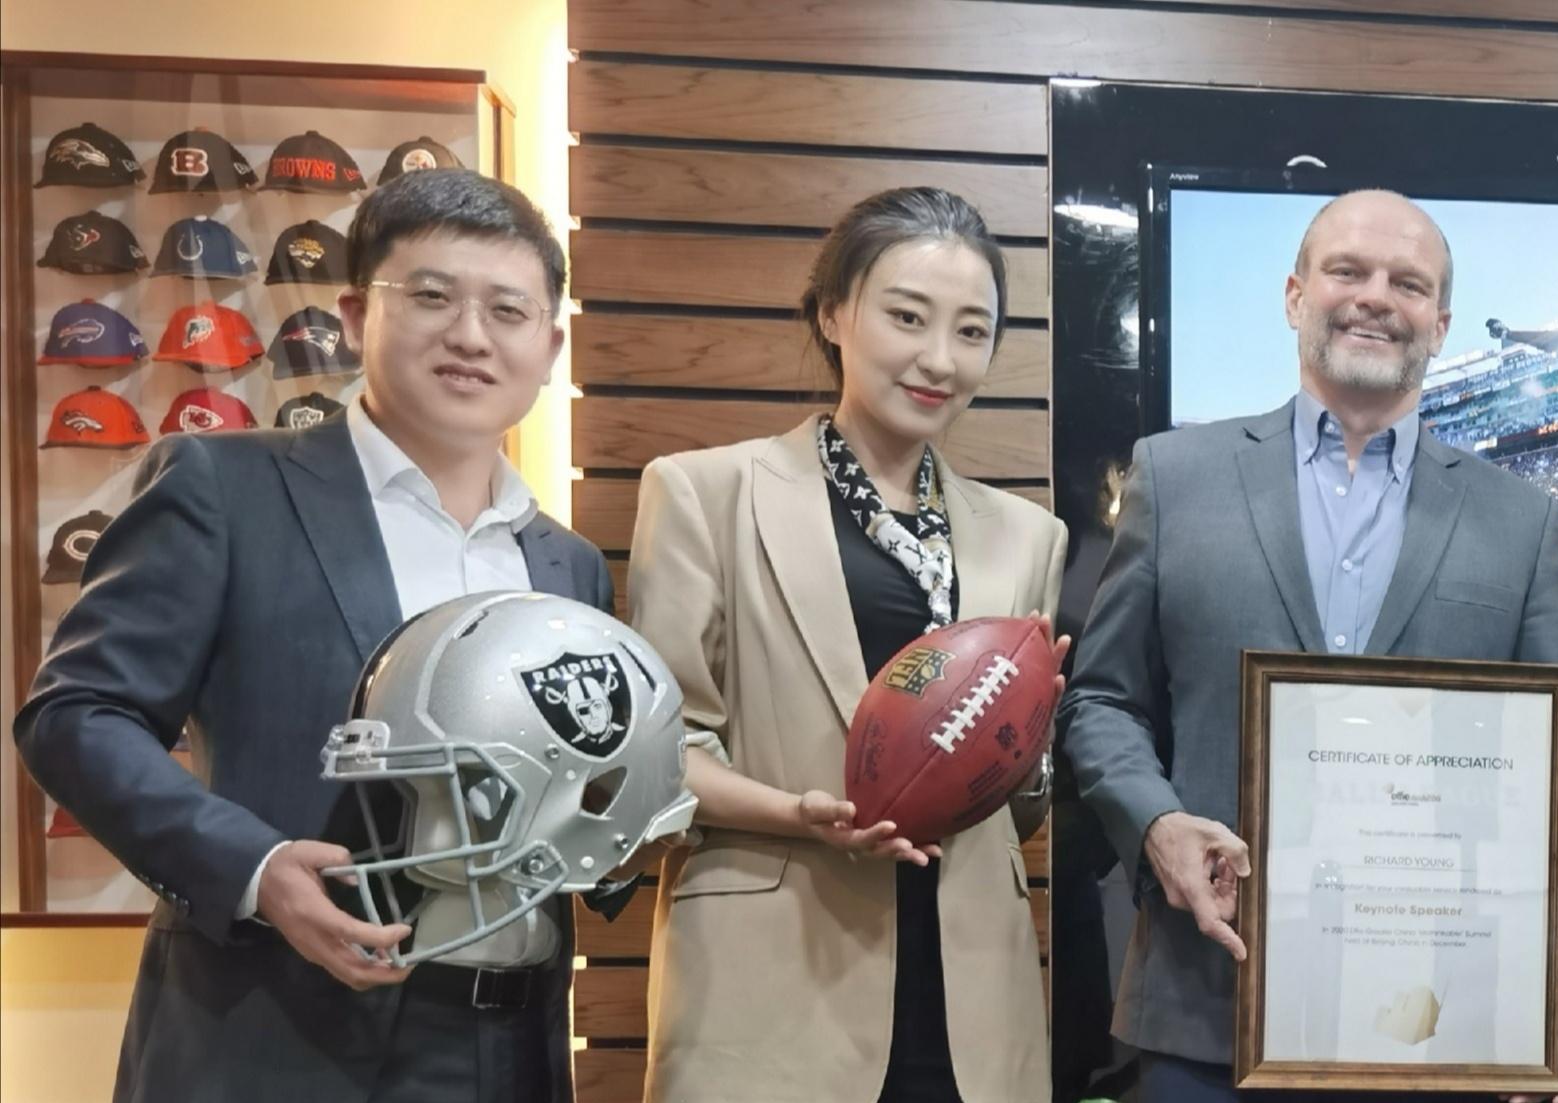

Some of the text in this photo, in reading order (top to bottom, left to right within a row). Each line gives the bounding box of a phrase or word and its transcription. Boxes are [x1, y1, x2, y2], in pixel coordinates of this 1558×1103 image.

[532, 655, 618, 683] RAIDERS
[1308, 750, 1514, 770] CERTIFICATE OF APPRECIATION
[1364, 855, 1455, 868] RICHARD YOUNG
[1354, 903, 1463, 917] Keynote Speaker
